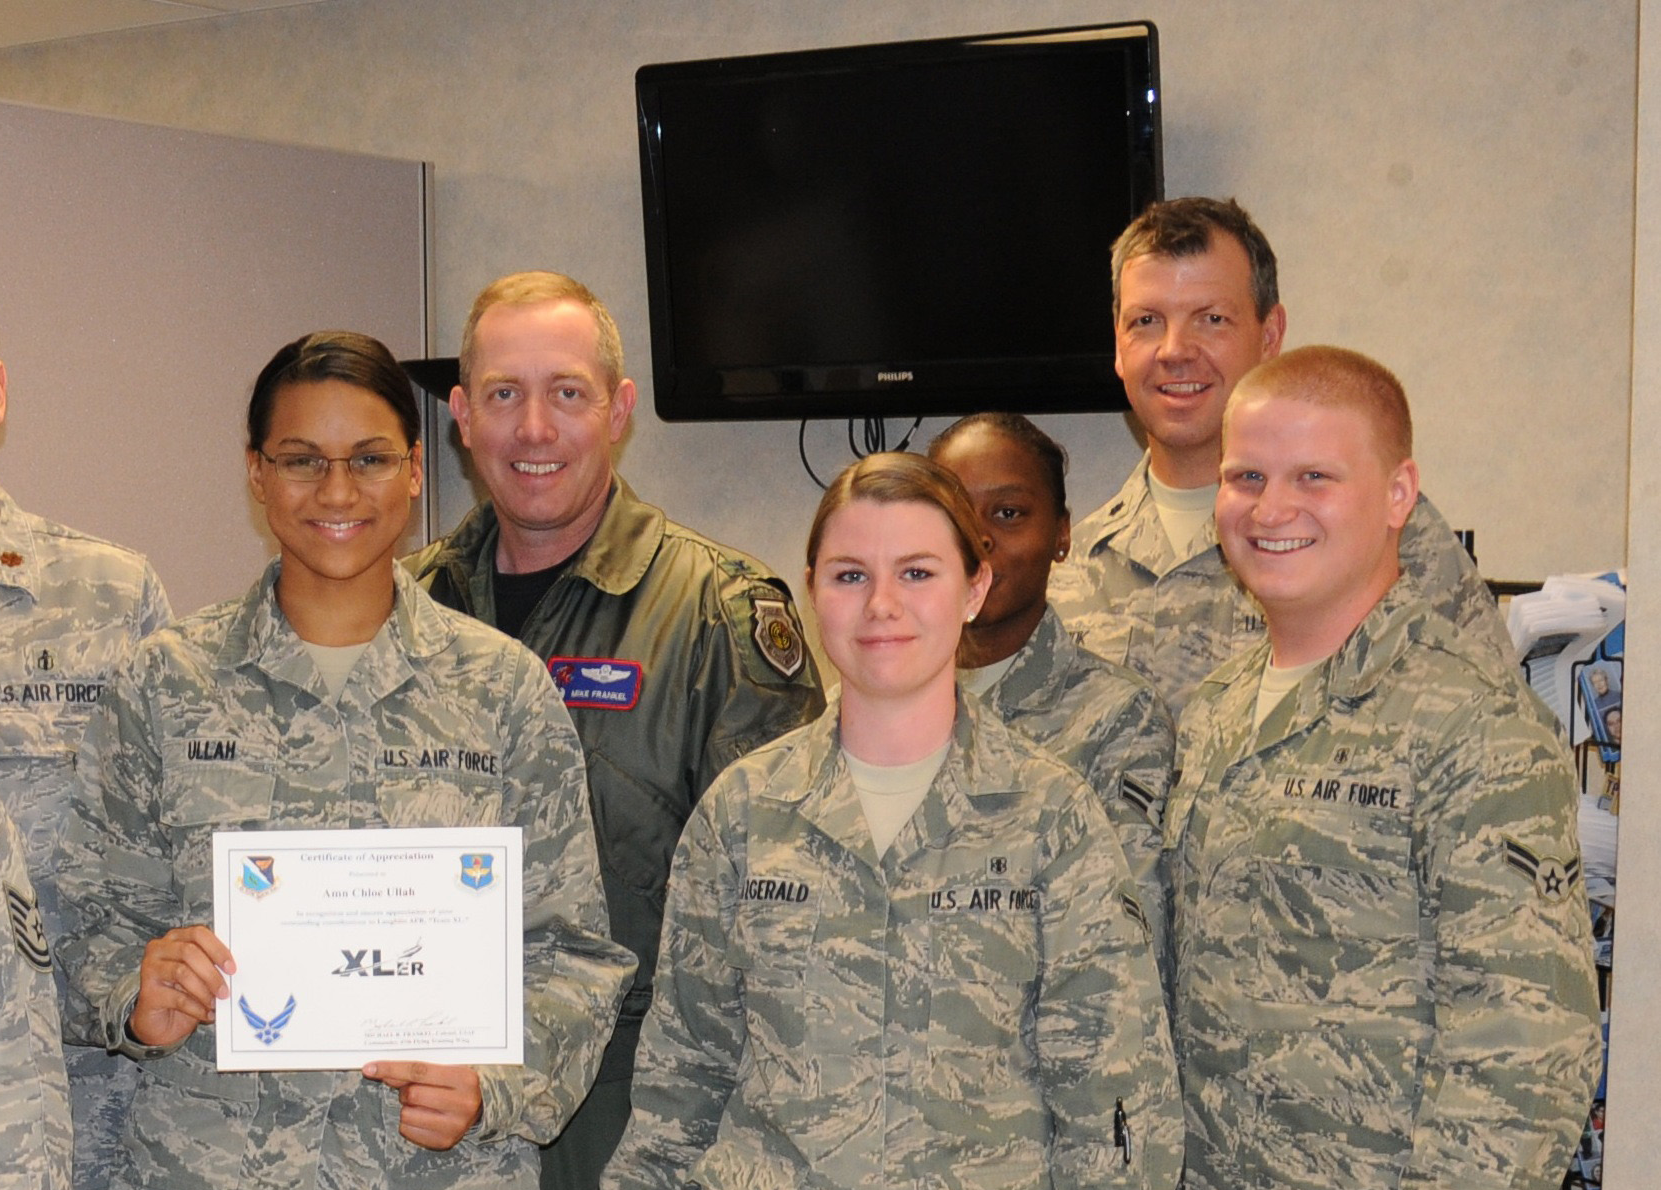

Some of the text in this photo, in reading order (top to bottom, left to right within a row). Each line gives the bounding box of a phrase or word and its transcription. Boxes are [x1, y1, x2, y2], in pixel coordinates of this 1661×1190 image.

[877, 371, 914, 382] PHILIPS
[22, 683, 52, 702] AIR
[187, 740, 237, 761] ULLAH
[420, 748, 449, 769] AIR
[458, 749, 498, 776] FORCE
[1312, 777, 1342, 801] AIR
[1348, 782, 1402, 810] FORCE
[300, 852, 435, 863] Certificate of Appreciation
[323, 889, 349, 899] Amn
[387, 887, 416, 897] Ullah
[969, 888, 1002, 911] AIR
